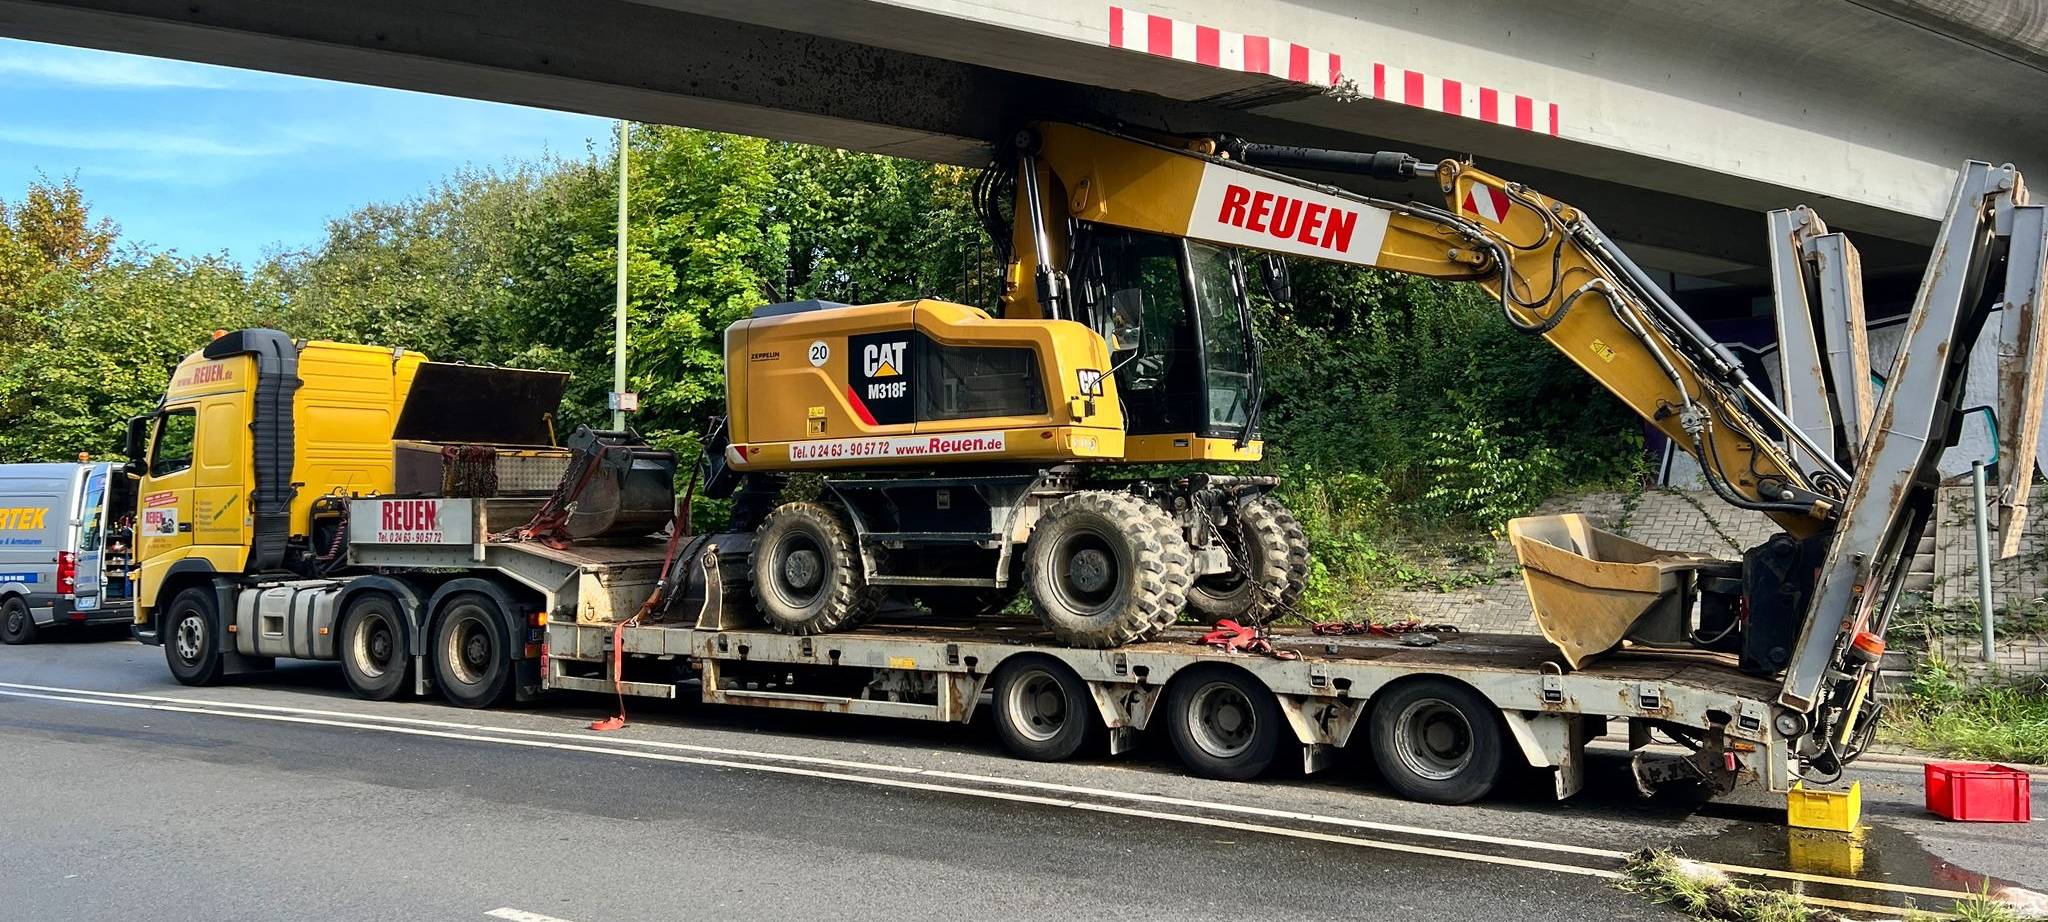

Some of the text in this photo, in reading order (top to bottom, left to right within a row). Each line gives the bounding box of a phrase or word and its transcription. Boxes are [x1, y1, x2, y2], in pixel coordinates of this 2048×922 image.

[1218, 184, 1358, 253] REUEN
[812, 345, 828, 360] 20
[864, 342, 907, 377] CAT
[868, 382, 907, 399] M318F
[793, 446, 807, 458] Tel.
[810, 446, 816, 458] 0
[818, 445, 829, 457] 24
[832, 444, 842, 456] 63
[850, 443, 862, 455] 90
[864, 442, 876, 455] 57
[878, 442, 890, 454] 72
[896, 438, 1002, 454] www.Reuen.de
[382, 500, 436, 530] REUEN
[378, 532, 388, 542] Tel.
[390, 532, 394, 542] 0
[394, 532, 402, 542] 24
[404, 532, 410, 542] 63
[416, 532, 424, 542] 90
[425, 532, 433, 542] 57
[434, 532, 442, 542] 72
